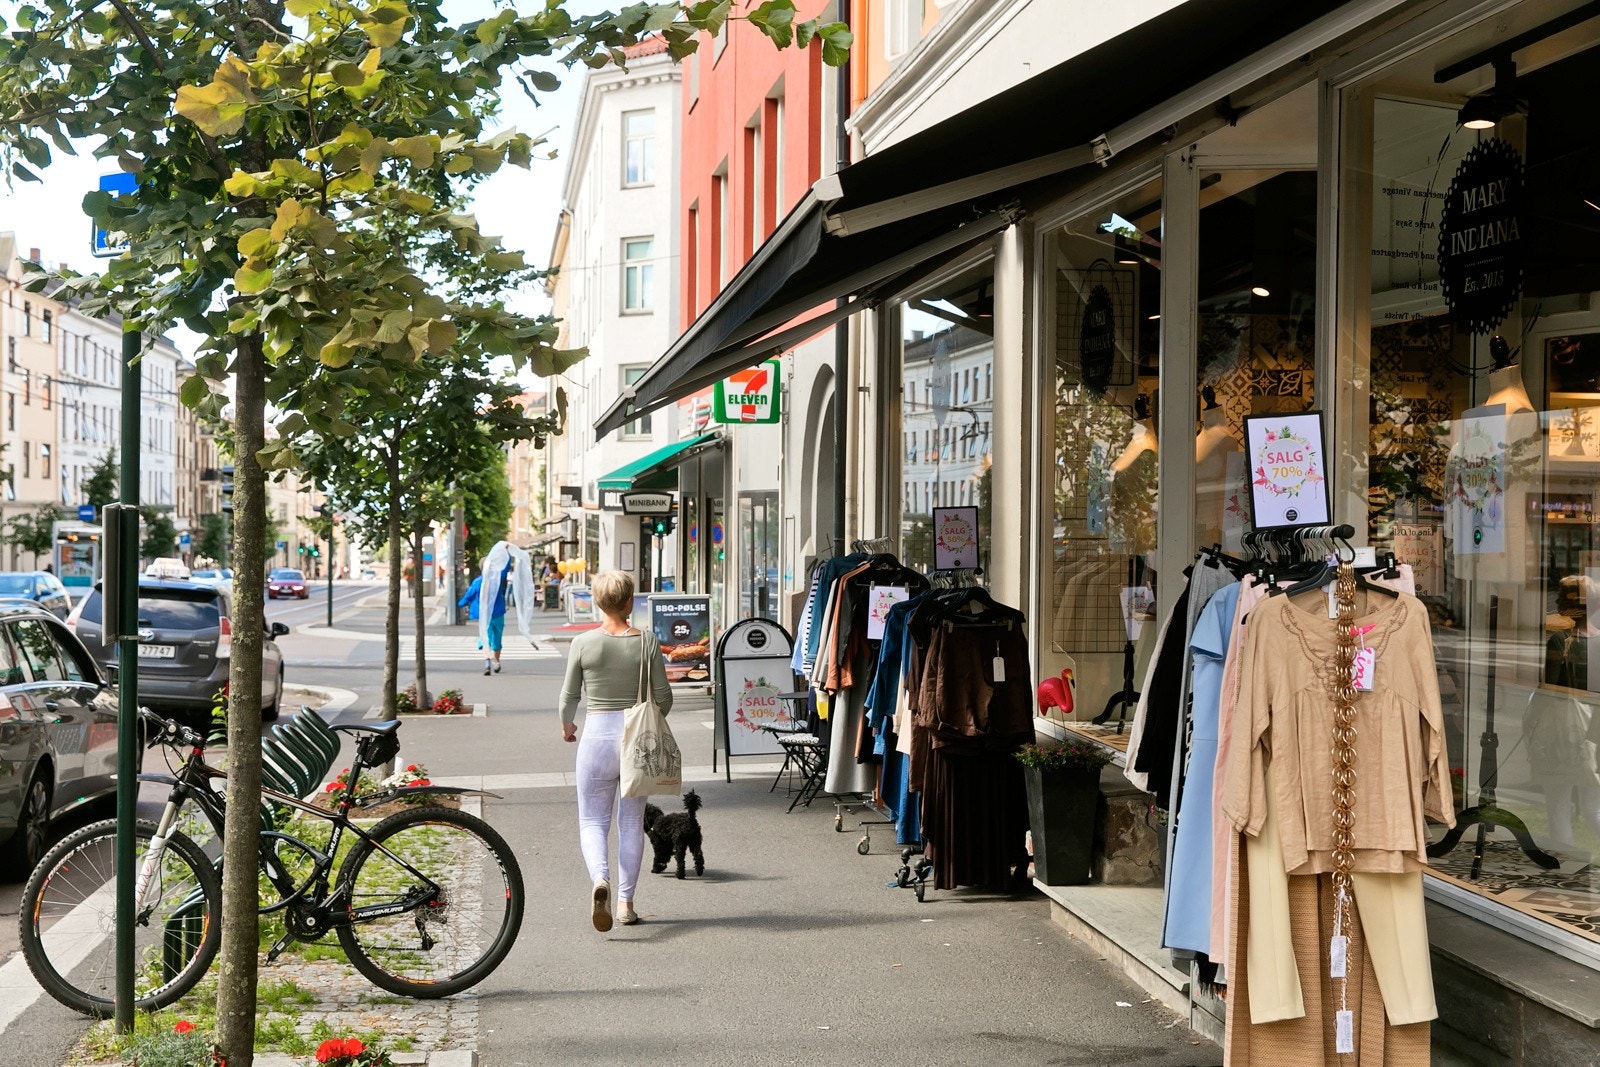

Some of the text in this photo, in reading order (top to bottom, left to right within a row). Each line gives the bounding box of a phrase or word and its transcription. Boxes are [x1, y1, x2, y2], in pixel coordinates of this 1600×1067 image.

[1462, 178, 1508, 214] MARY
[1450, 216, 1520, 256] INDIANA
[1482, 269, 1504, 290] 2015
[729, 370, 767, 421] 7
[1267, 450, 1304, 465] SALG
[1271, 465, 1303, 479] 70%
[1465, 472, 1487, 488] 30%
[628, 499, 667, 507] MINIBANK
[944, 527, 966, 535] SALG
[1405, 548, 1429, 556] SALG
[655, 603, 706, 612] BBQ-PØLSE
[142, 645, 171, 655] 27747
[745, 696, 776, 706] SALG
[749, 708, 775, 719] 30%
